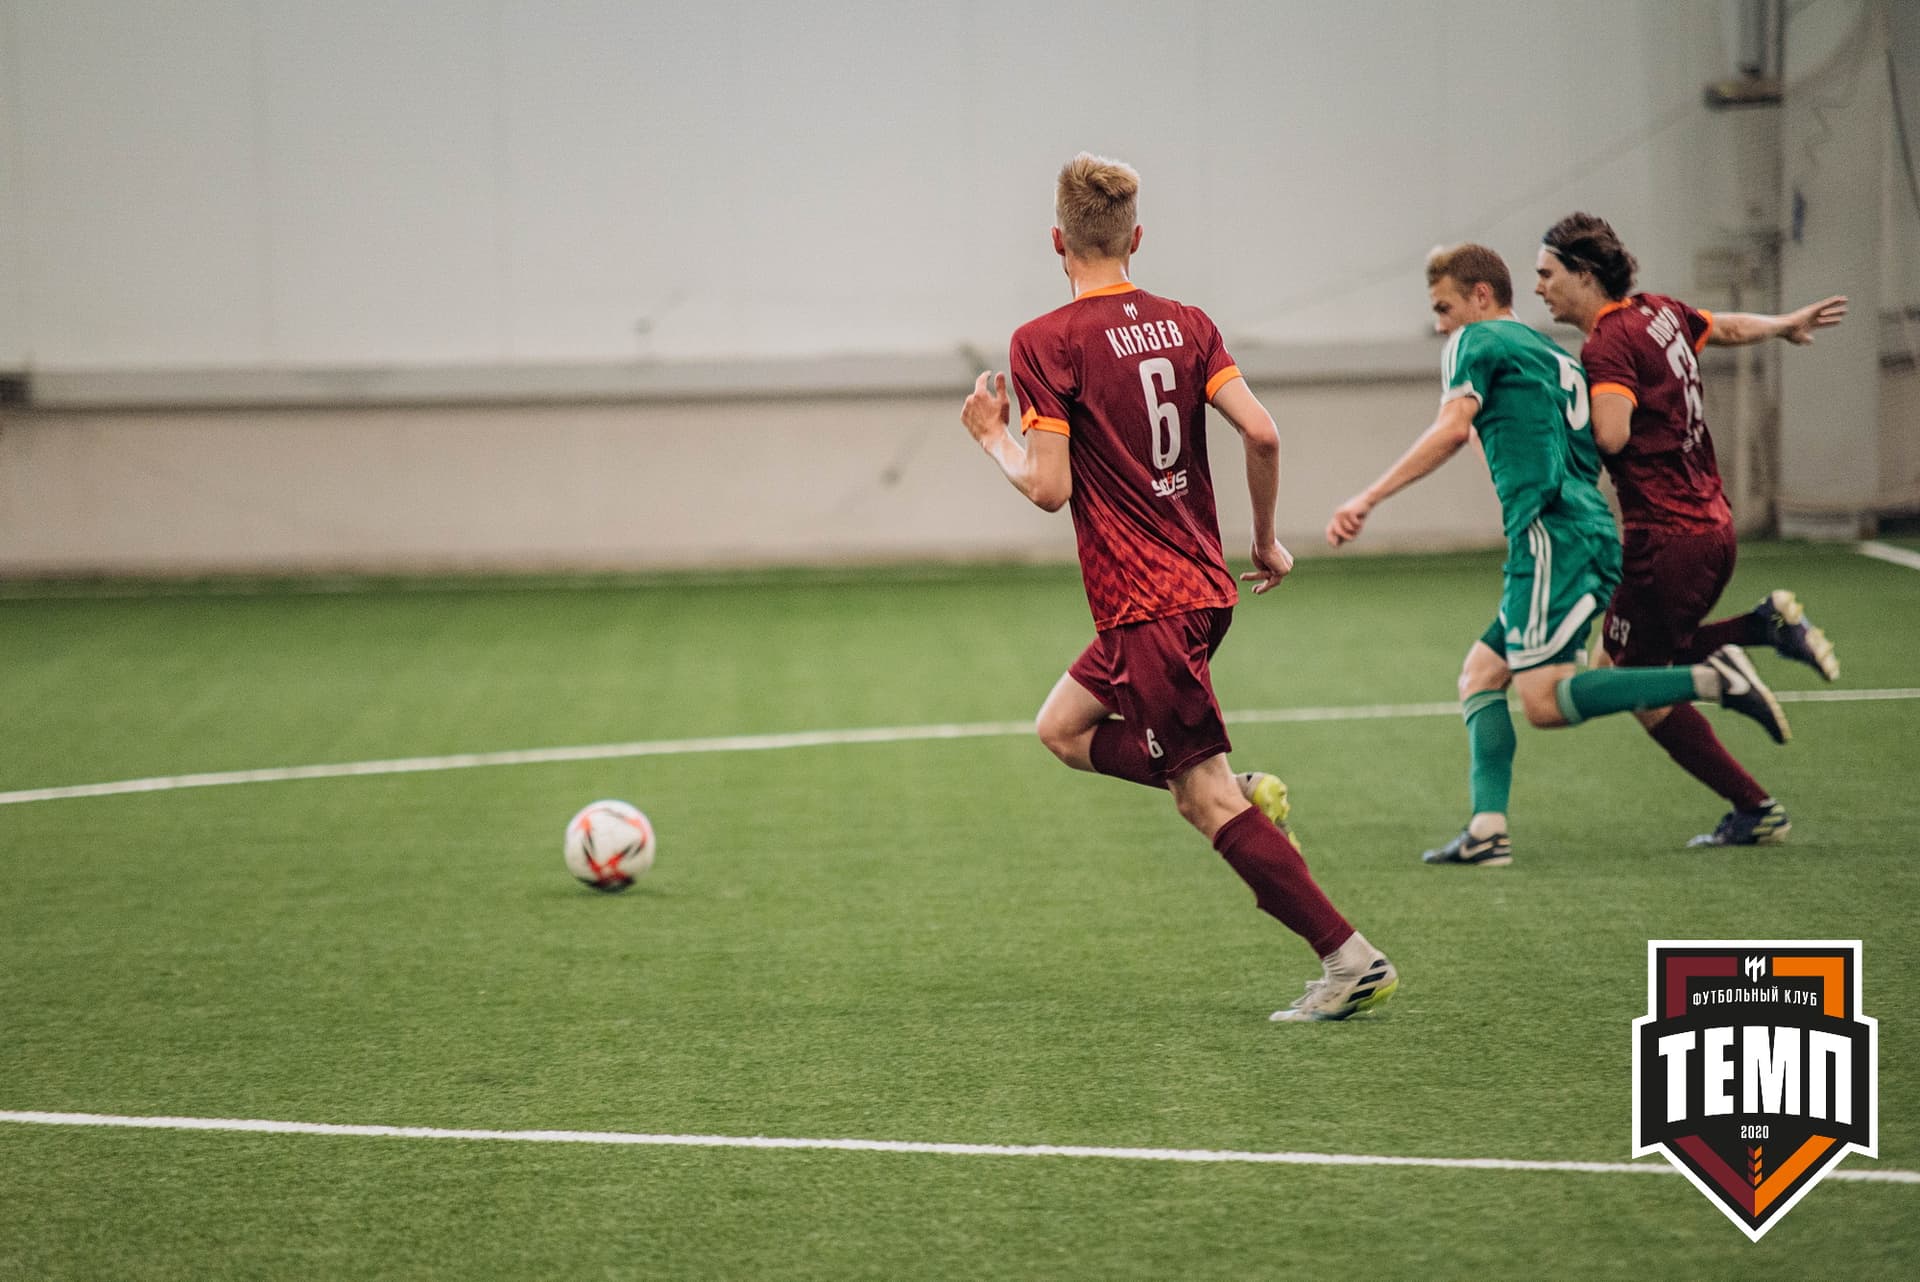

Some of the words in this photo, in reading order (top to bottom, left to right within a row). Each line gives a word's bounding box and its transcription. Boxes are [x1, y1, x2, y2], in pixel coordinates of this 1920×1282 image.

[1105, 319, 1184, 359] КНЯЗЕВ
[1139, 357, 1181, 470] 6
[1549, 350, 1590, 431] 5
[1146, 728, 1164, 759] 6
